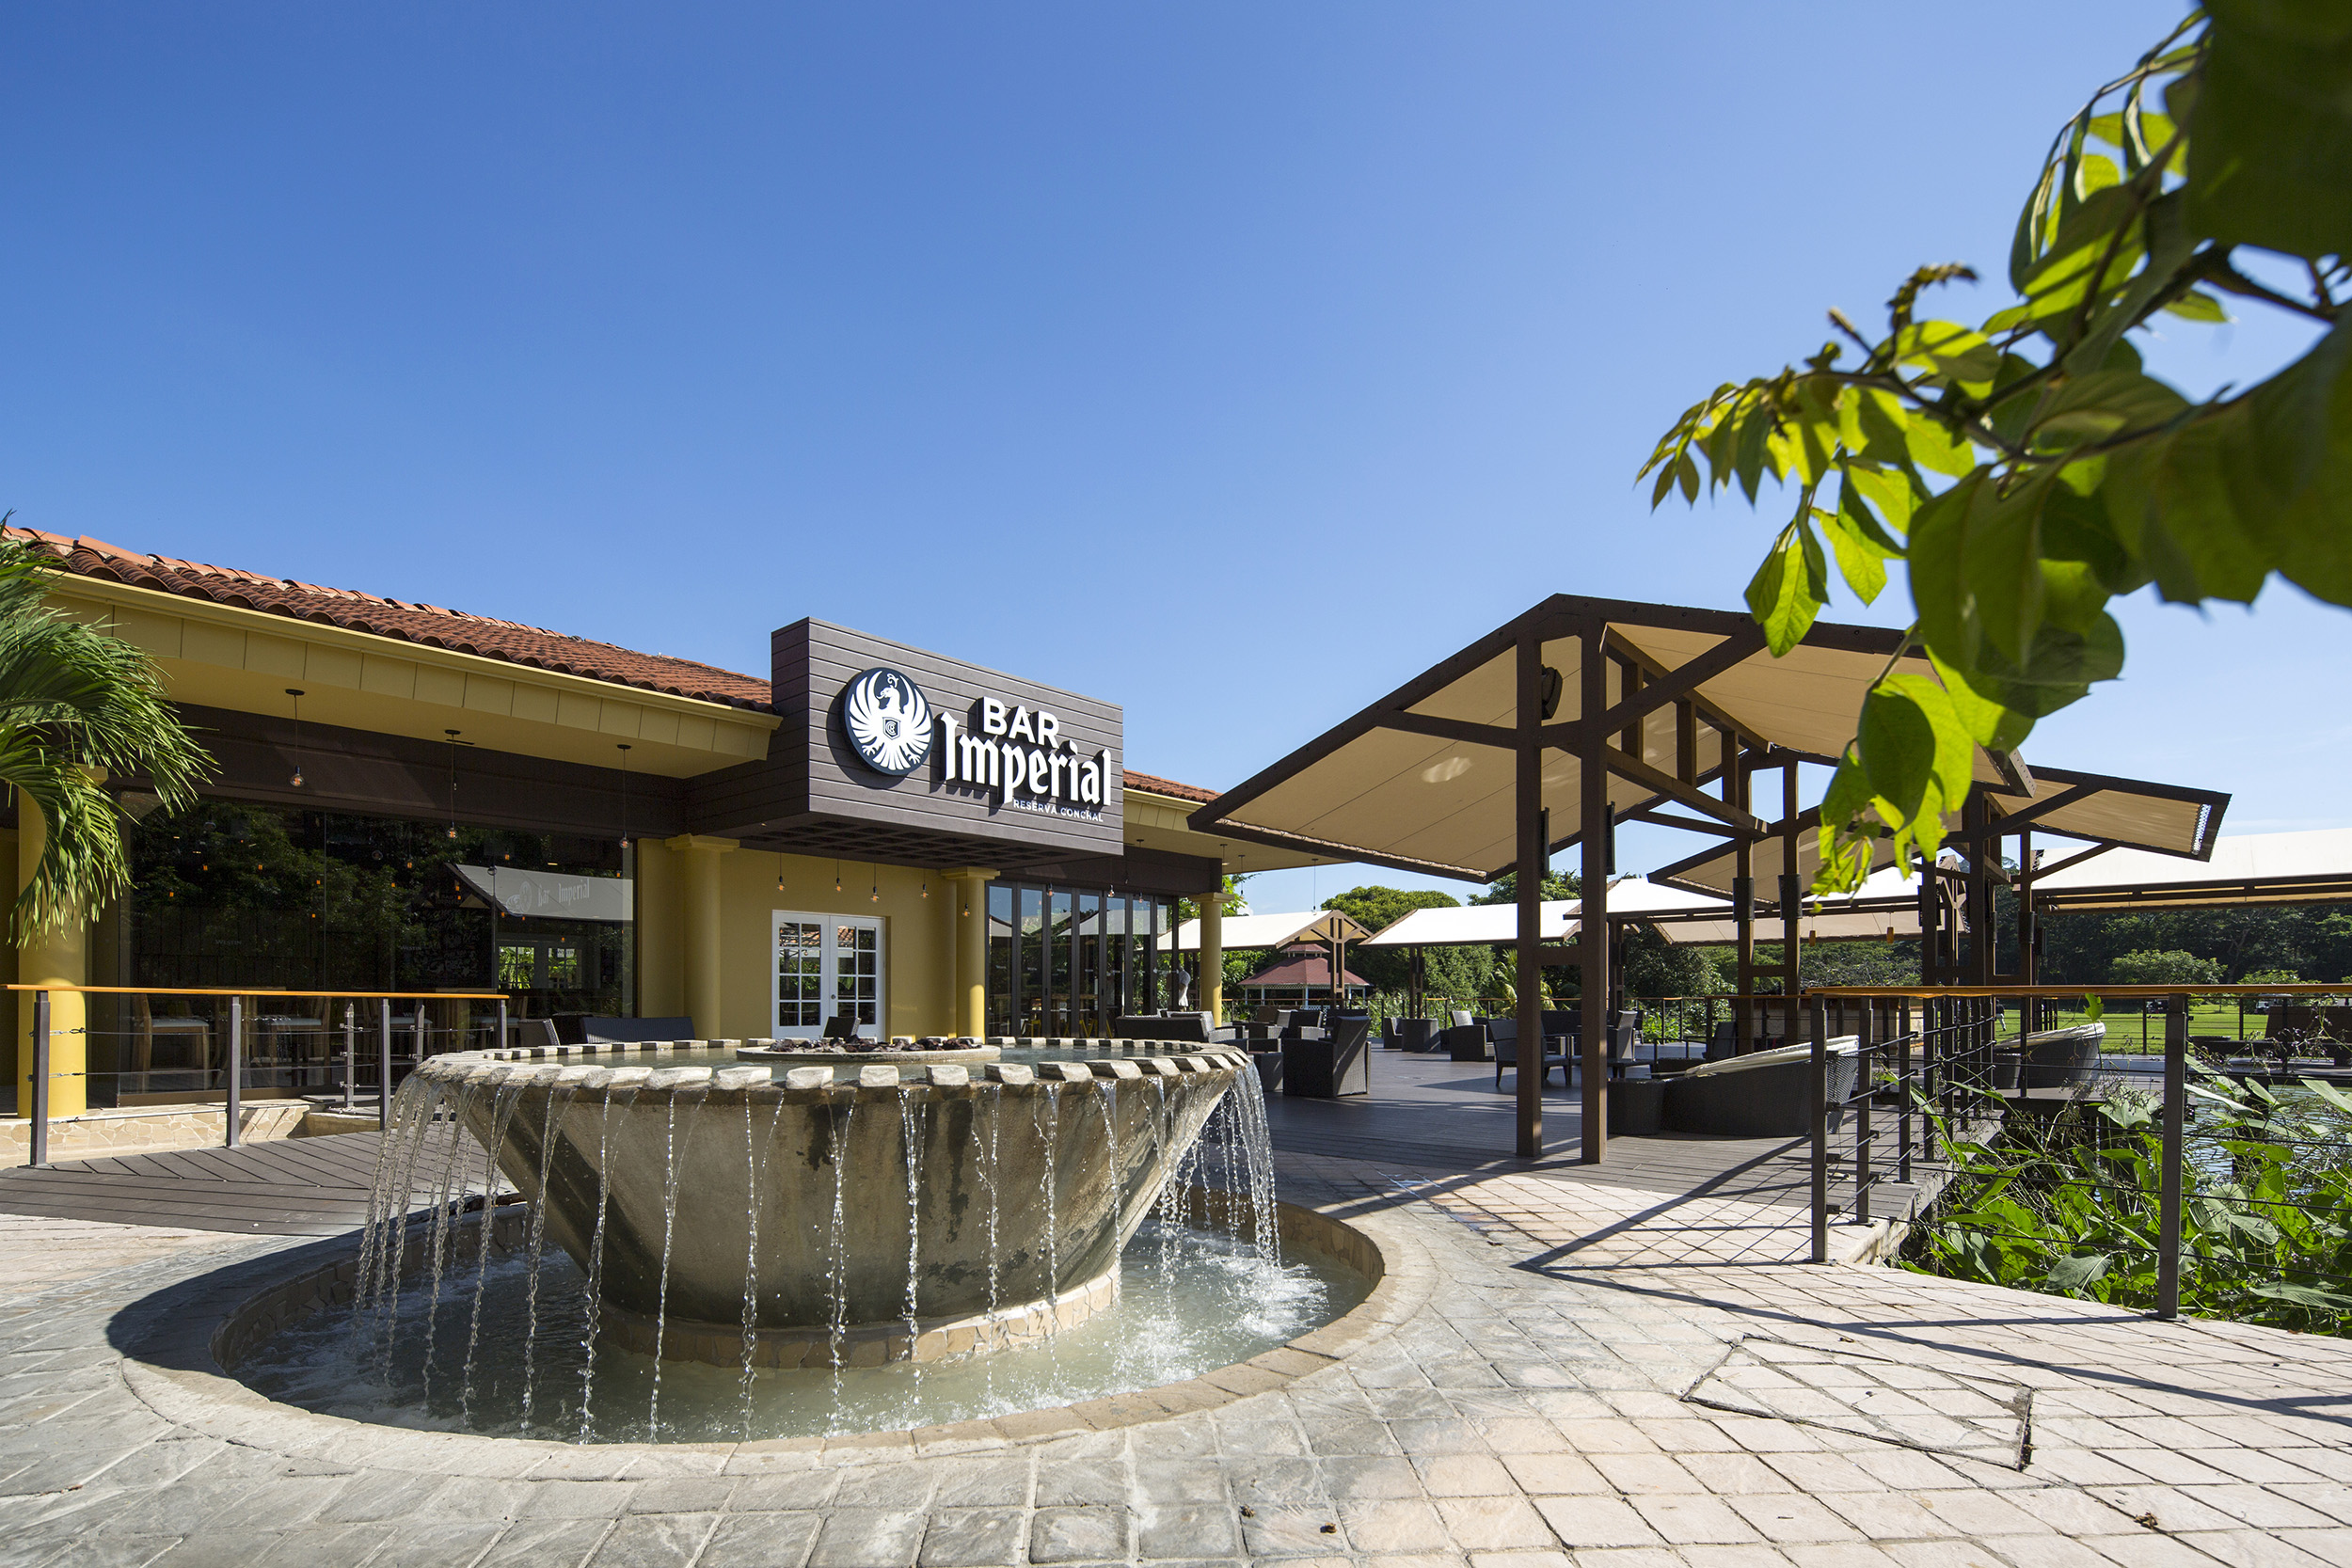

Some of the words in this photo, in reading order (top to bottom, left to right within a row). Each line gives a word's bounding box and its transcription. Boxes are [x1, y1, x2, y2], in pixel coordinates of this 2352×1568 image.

[983, 696, 1058, 748] BAR
[941, 711, 1111, 805] Imperial
[1013, 799, 1057, 815] RESERVA
[1061, 807, 1104, 822] CONCHAL
[558, 878, 589, 906] Imperial
